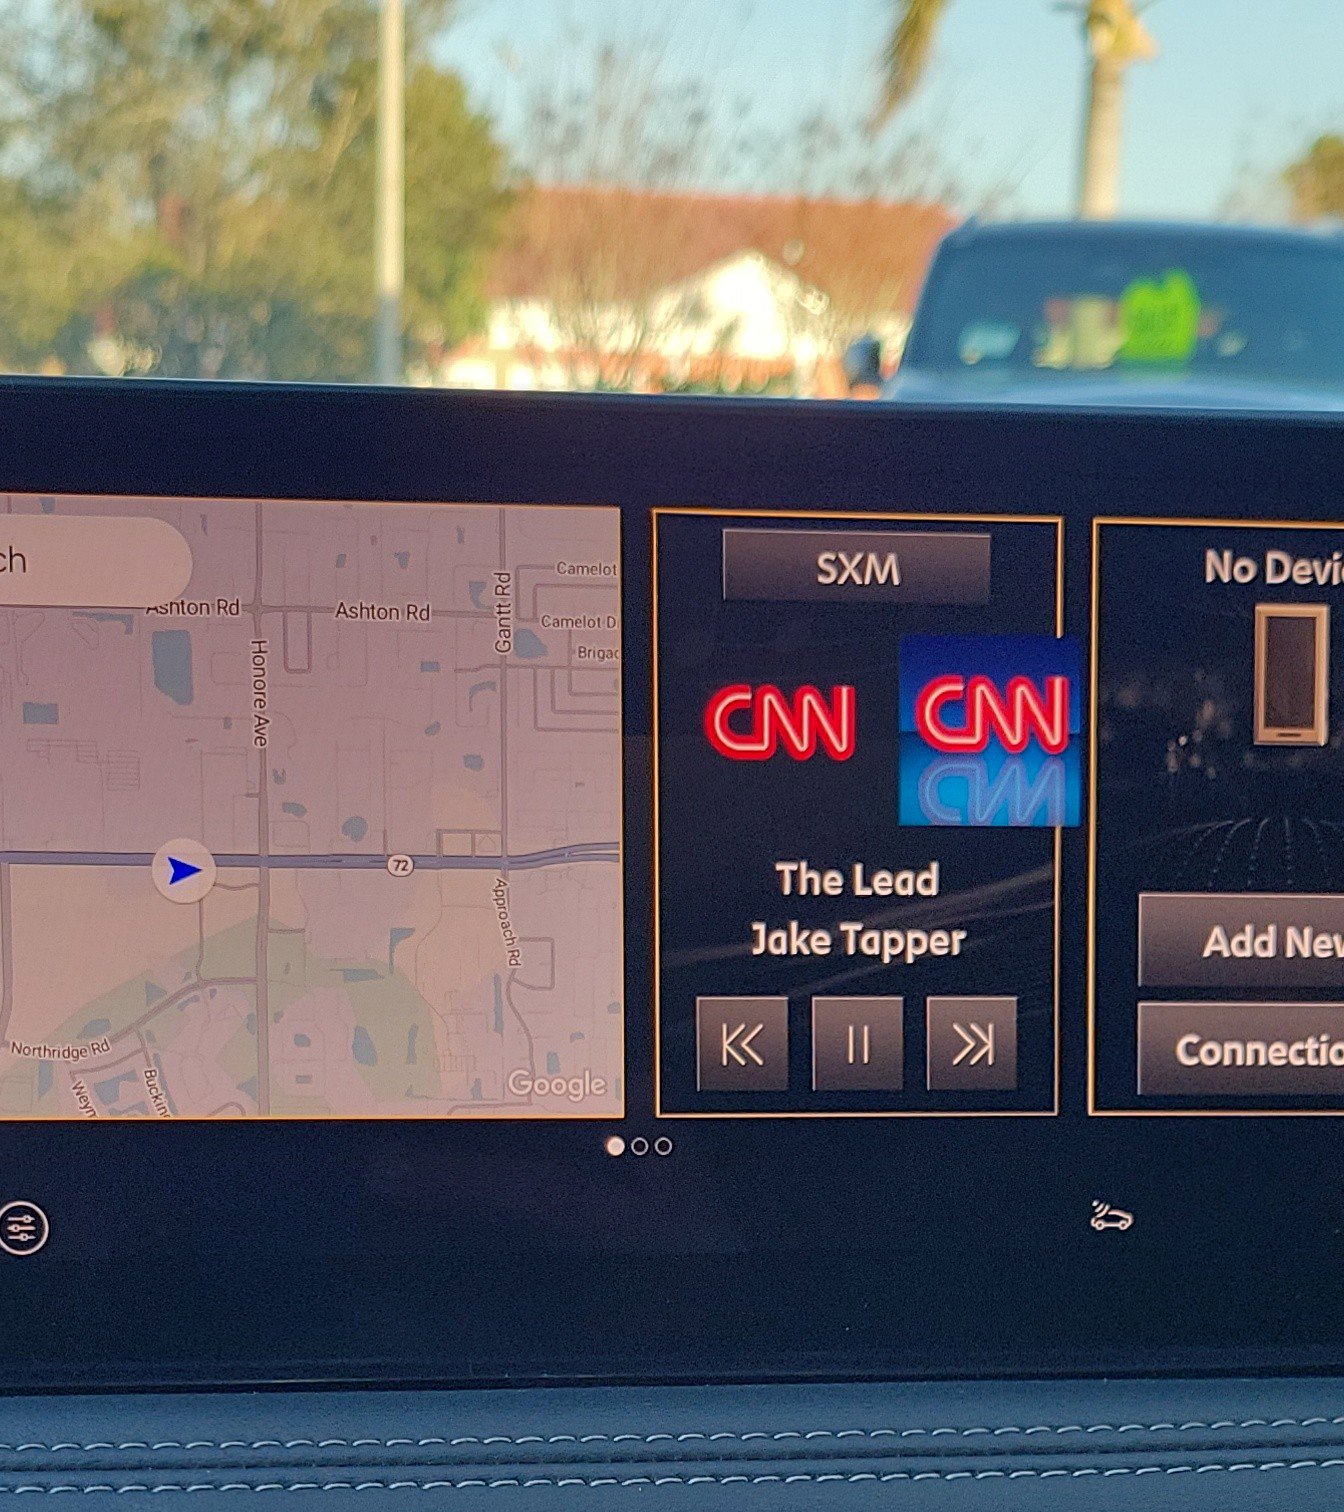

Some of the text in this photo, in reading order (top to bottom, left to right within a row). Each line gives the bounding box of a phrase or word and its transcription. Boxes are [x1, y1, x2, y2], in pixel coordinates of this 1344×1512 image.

[556, 561, 617, 576] Camelot
[817, 552, 901, 586] SXM
[1205, 549, 1257, 584] No
[216, 598, 240, 616] Rd
[335, 601, 430, 621] Ashton Rd
[493, 572, 511, 653] Gantt Rd
[541, 614, 619, 628] Camelot D
[251, 640, 270, 747] Honore Ave
[704, 684, 855, 761] CNN
[915, 675, 1069, 755] CNN
[393, 860, 409, 871] 72
[775, 860, 940, 897] The Lead
[492, 878, 522, 966] Approach Rd
[751, 920, 968, 964] Jake Tapper
[1202, 924, 1276, 959] Add
[11, 1038, 111, 1062] Northridge Rd
[508, 1069, 606, 1102] Google
